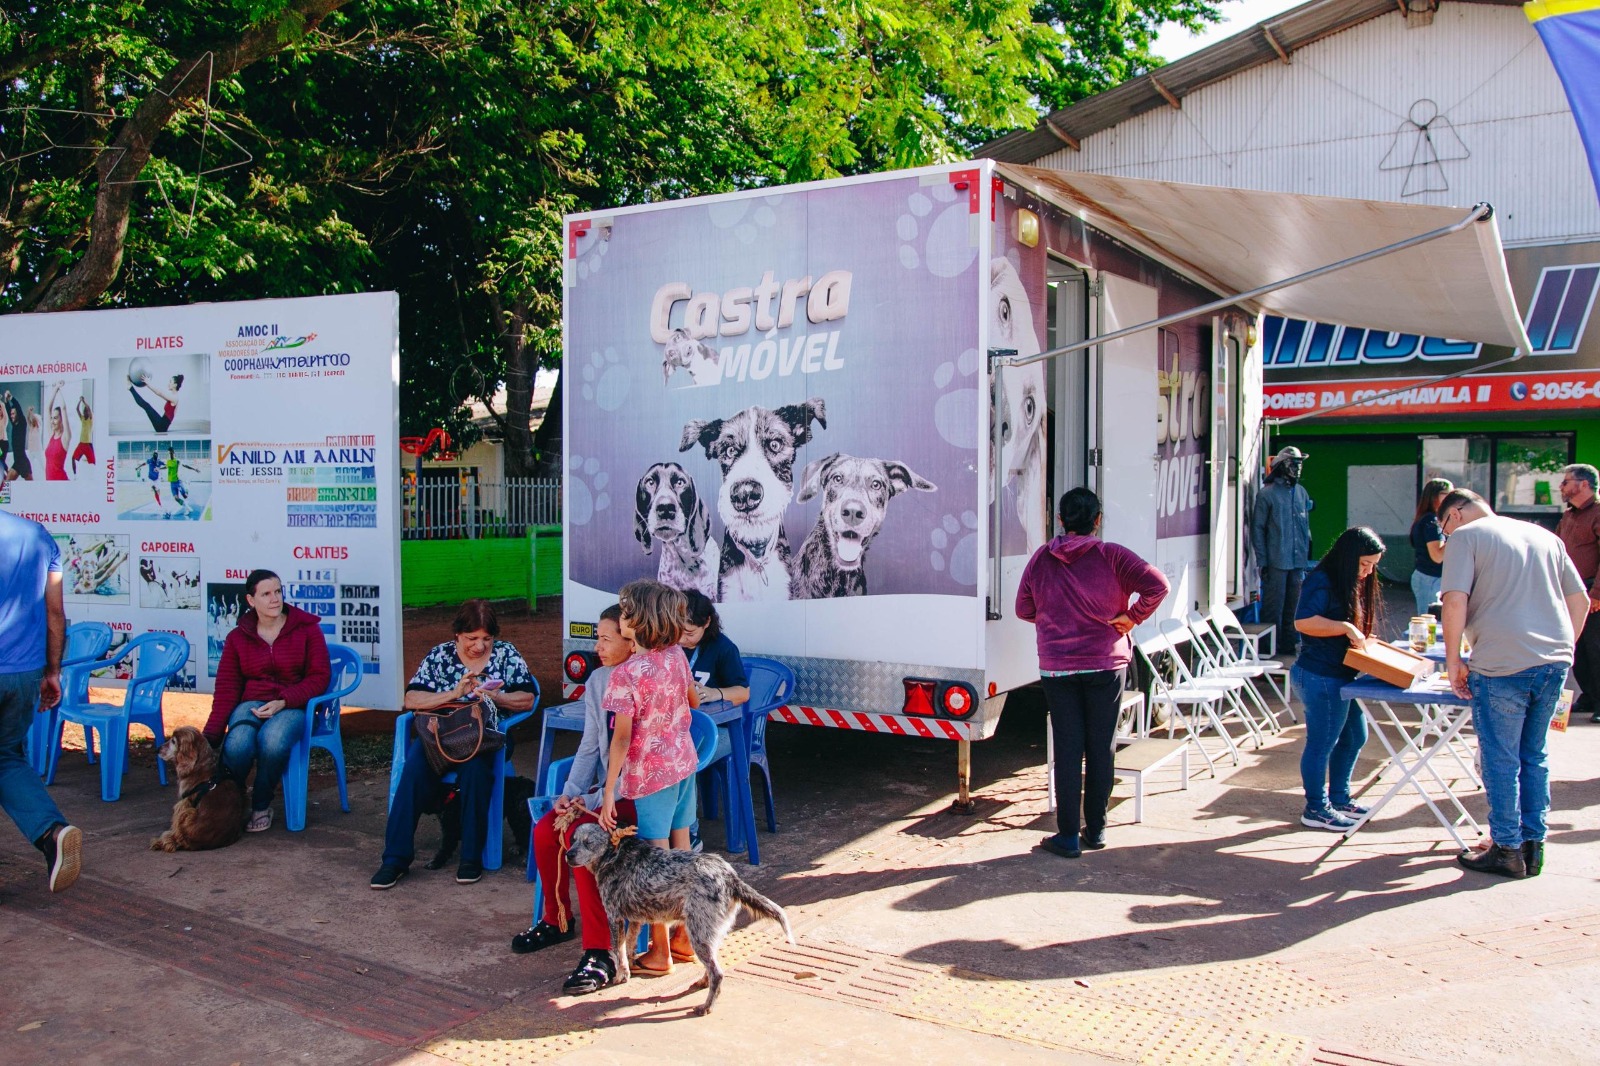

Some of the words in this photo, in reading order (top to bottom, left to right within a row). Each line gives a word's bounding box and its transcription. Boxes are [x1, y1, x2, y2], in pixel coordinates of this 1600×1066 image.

[650, 269, 853, 345] Castra
[237, 325, 268, 338] AMOC
[271, 324, 279, 336] II
[136, 336, 184, 350] PILATES
[718, 328, 846, 384] MÓVEL
[36, 361, 88, 374] AERÓBRICA
[1320, 391, 1347, 408] DA
[1352, 385, 1472, 407] COOPHAVILA
[1476, 385, 1492, 402] II
[220, 467, 244, 477] VICE:
[106, 456, 115, 503] FUTSAL
[52, 513, 58, 523] E
[60, 511, 100, 525] NATAÇÃO
[141, 541, 195, 553] CAPOEIRA
[572, 625, 591, 634] EURO
